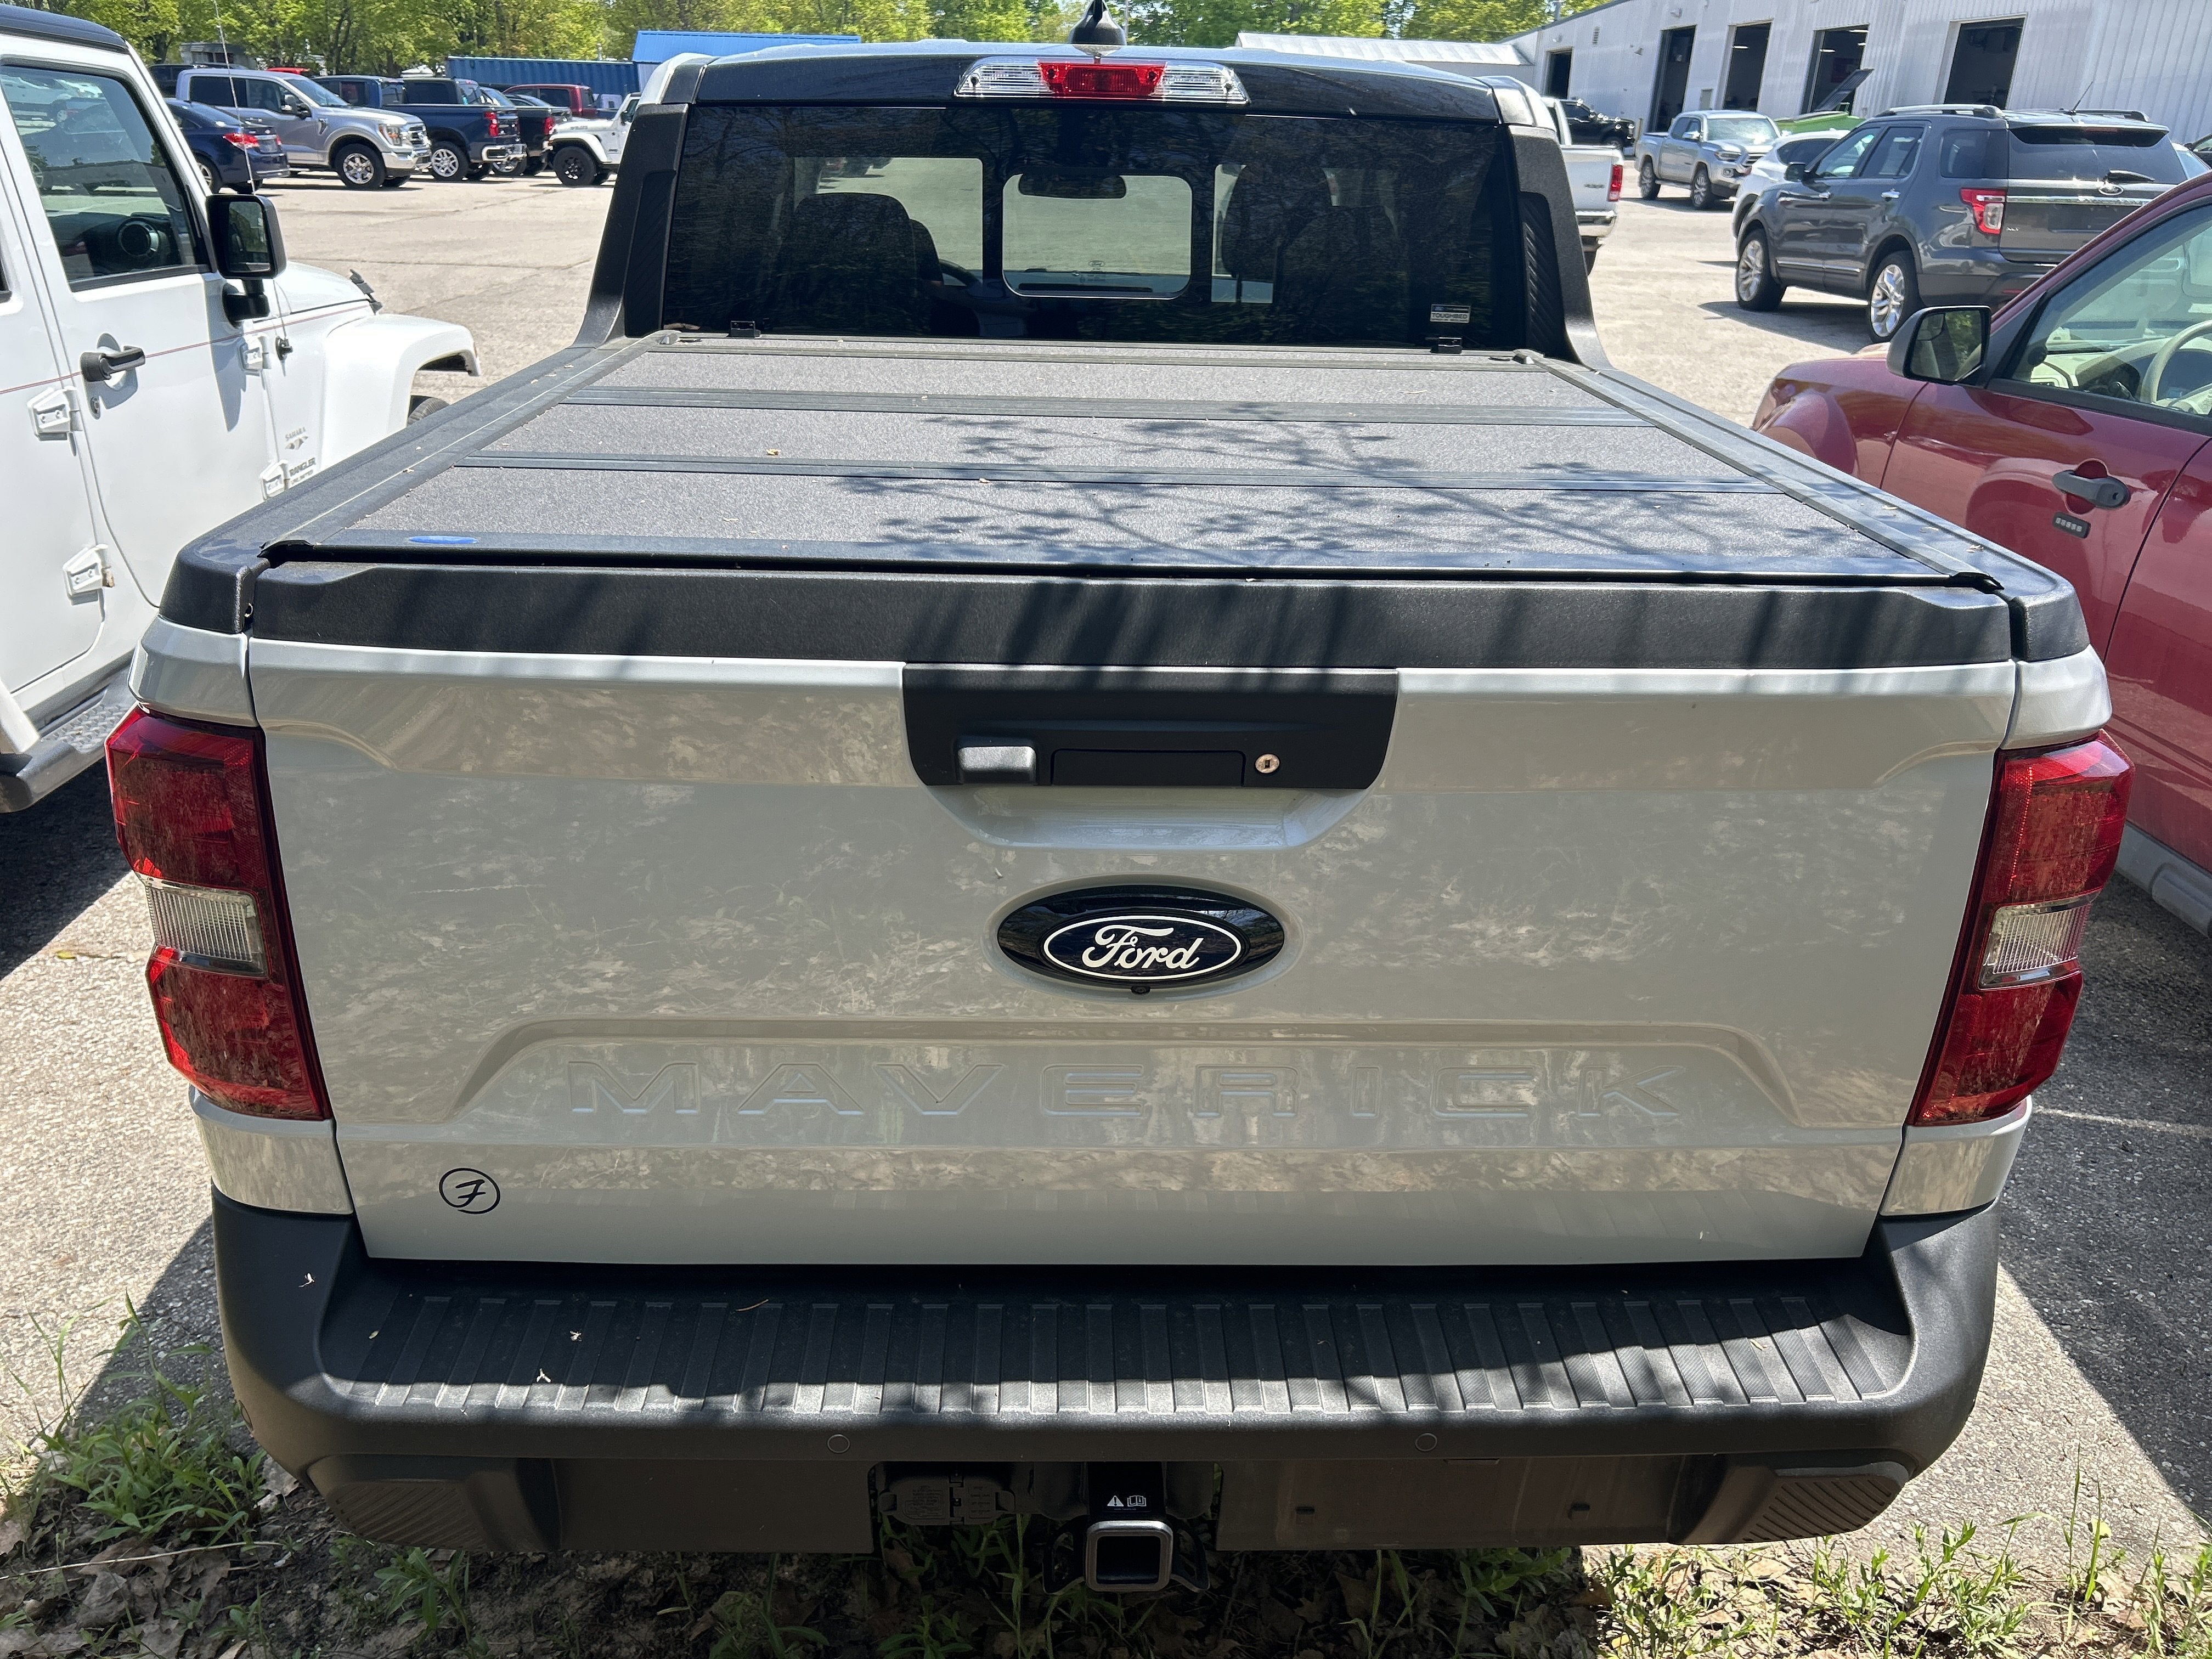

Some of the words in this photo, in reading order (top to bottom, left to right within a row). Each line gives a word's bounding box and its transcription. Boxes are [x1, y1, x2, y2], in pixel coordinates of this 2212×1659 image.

[289, 458, 316, 477] RANGLER
[1081, 924, 1204, 969] Ford
[568, 1061, 1686, 1119] MAVERICK
